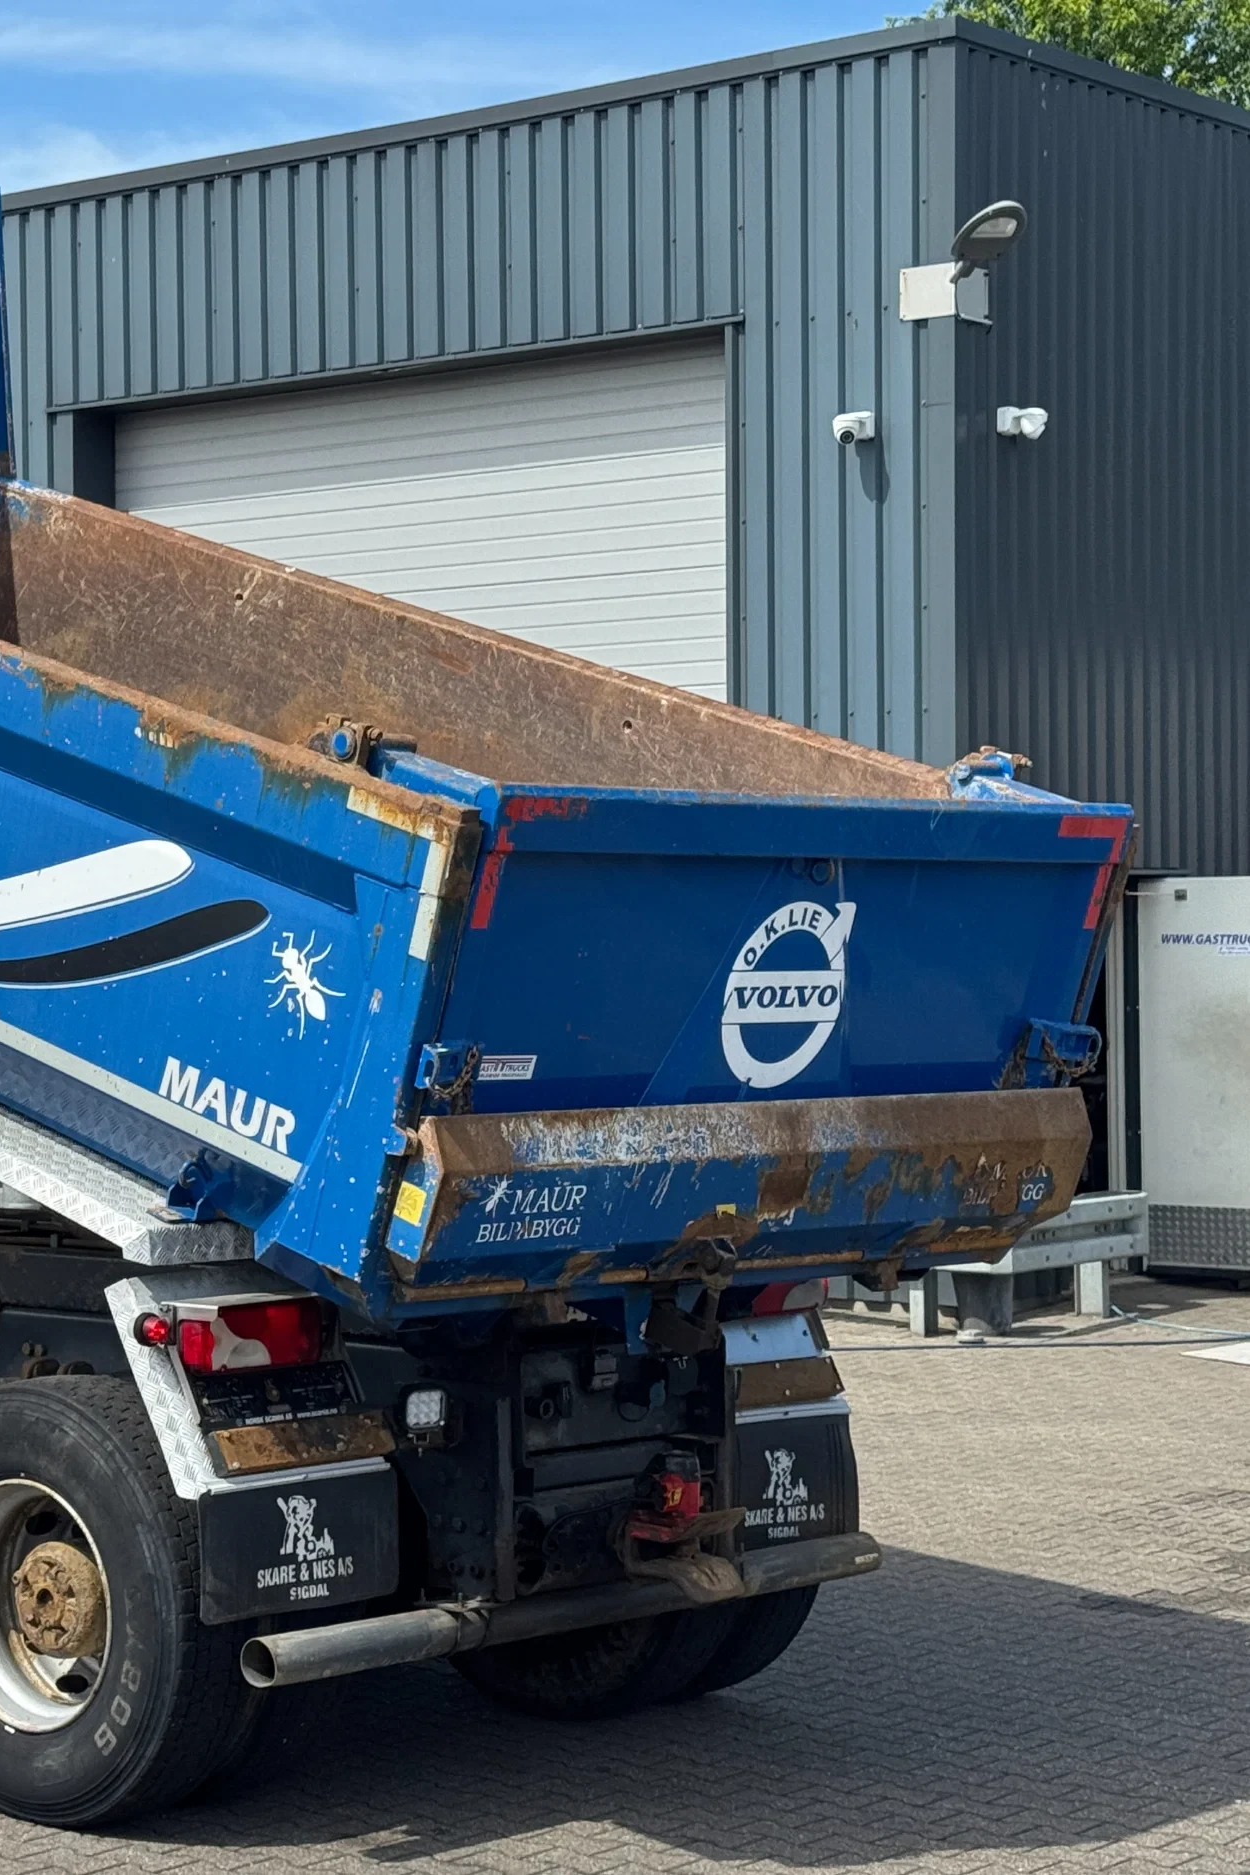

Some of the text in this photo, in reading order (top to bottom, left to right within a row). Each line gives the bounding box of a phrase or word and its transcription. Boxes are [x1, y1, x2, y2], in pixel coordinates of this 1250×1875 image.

[734, 985, 838, 1009] VOLVO
[158, 1055, 296, 1154] MAUR
[744, 1507, 774, 1527] SKARE
[776, 1506, 786, 1523] &
[257, 1555, 354, 1588] SKARE & NES A/S
[290, 1583, 330, 1600] SIGDAL
